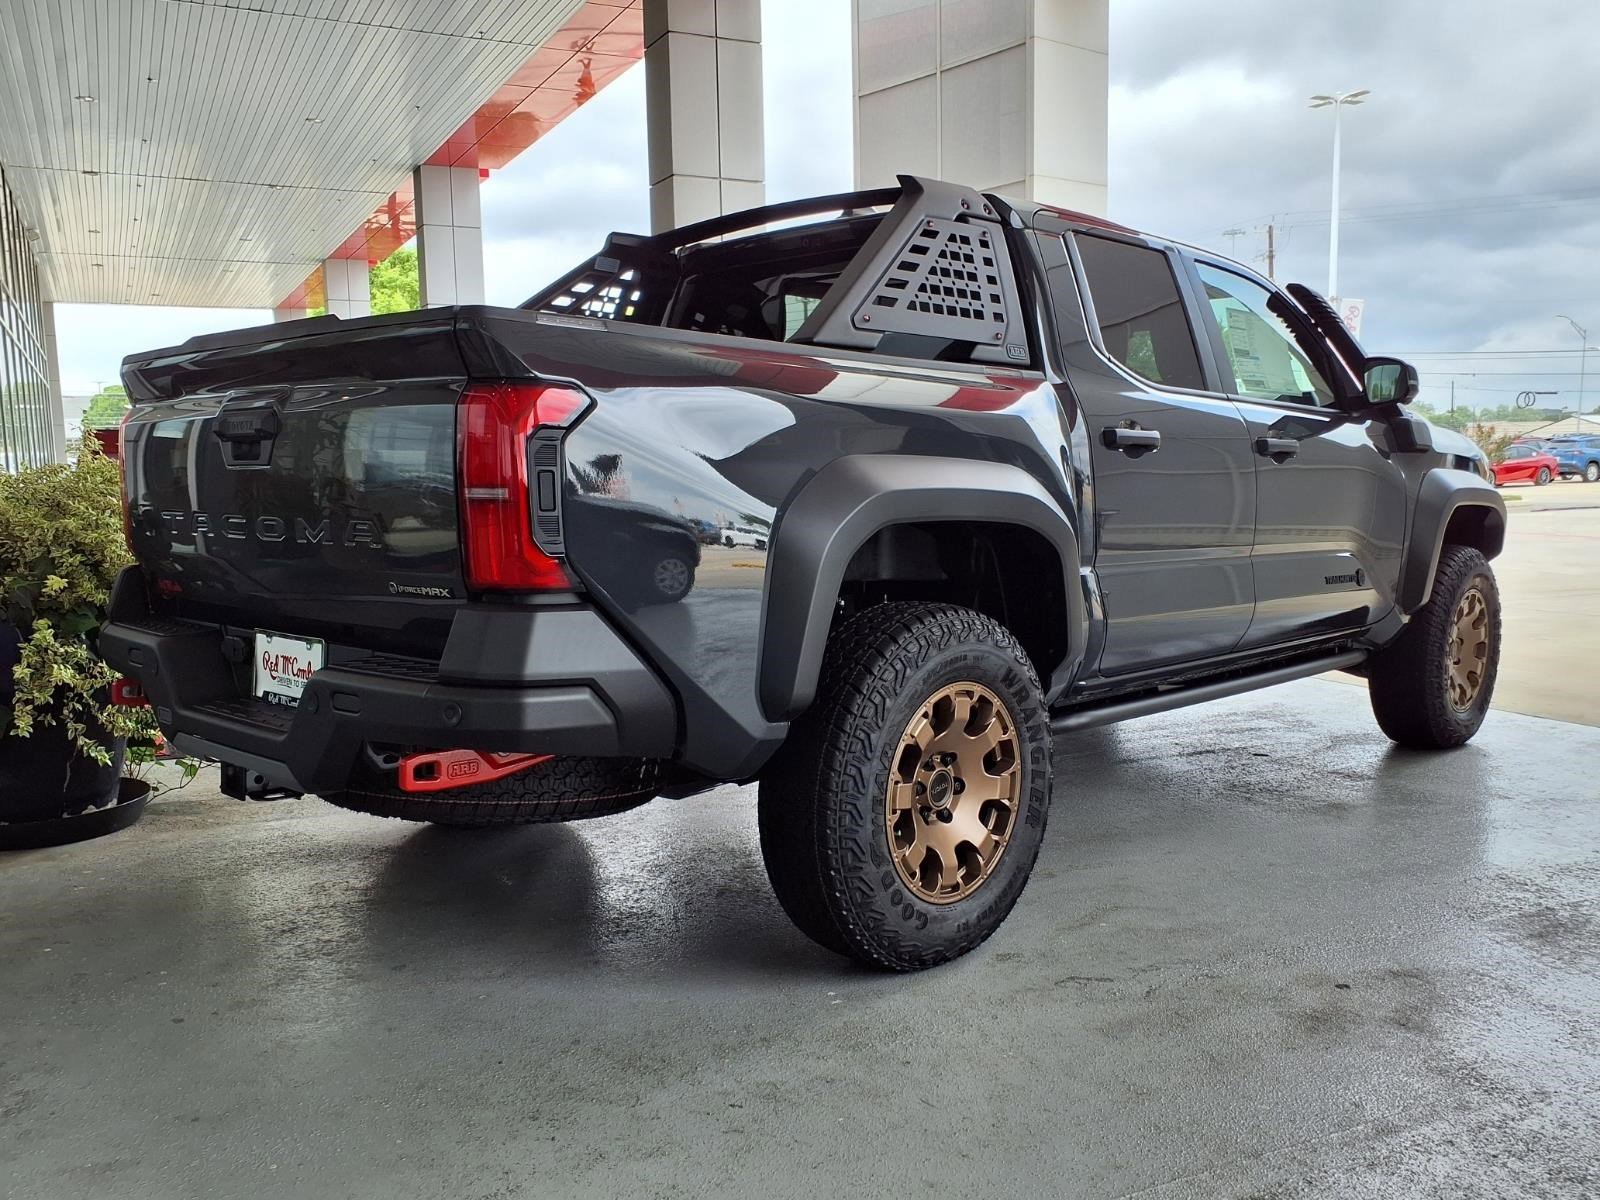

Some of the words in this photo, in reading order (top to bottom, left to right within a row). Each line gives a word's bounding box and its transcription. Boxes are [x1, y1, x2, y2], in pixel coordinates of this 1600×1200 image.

[161, 510, 382, 549] TACOMA
[263, 650, 279, 680] Red
[1000, 666, 1047, 829] WRANGLER
[450, 761, 479, 777] ARB
